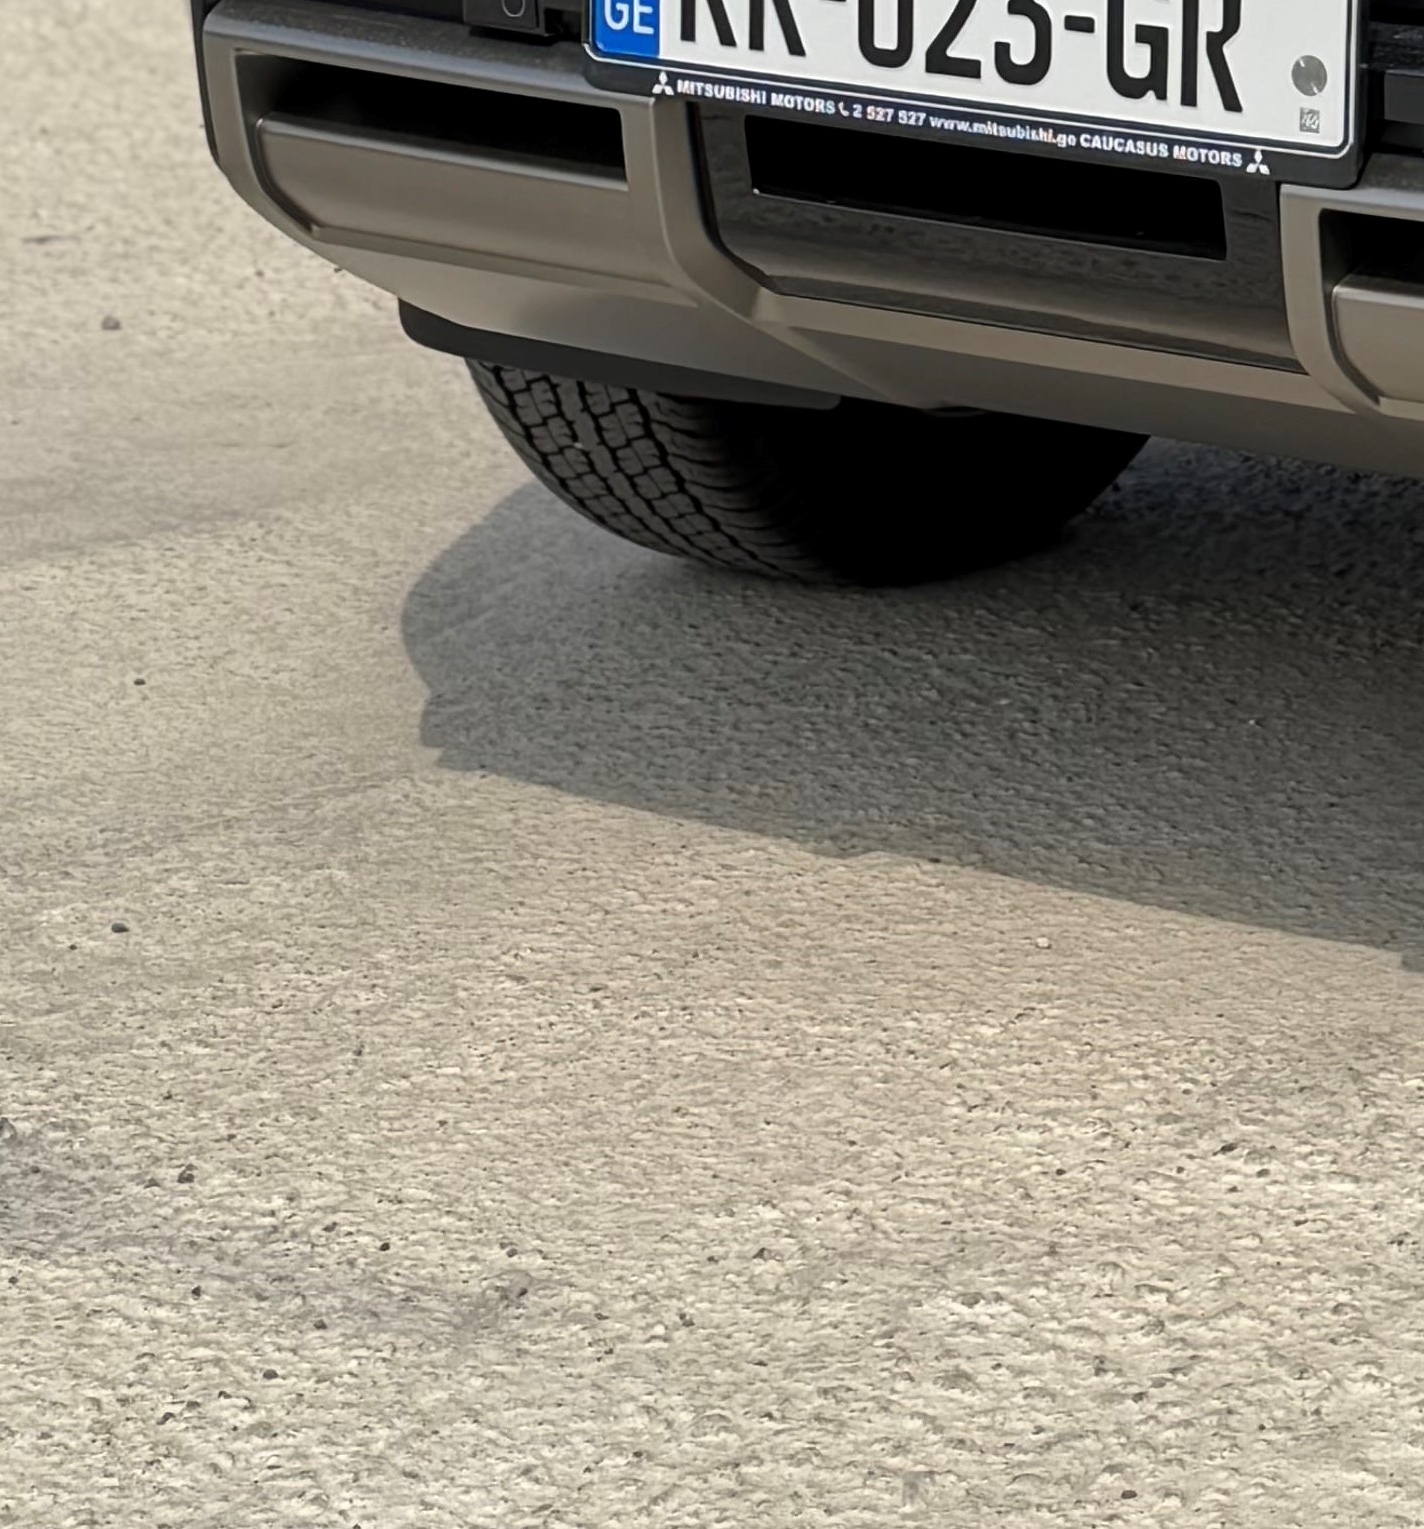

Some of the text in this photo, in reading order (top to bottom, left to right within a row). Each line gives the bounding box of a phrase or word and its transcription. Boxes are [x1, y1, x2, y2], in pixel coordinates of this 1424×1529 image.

[676, 78, 767, 106] MITSUBISHI
[771, 92, 836, 115] MOTORS
[1080, 132, 1169, 158] CAUCASUS
[1172, 144, 1243, 168] MOTORS
